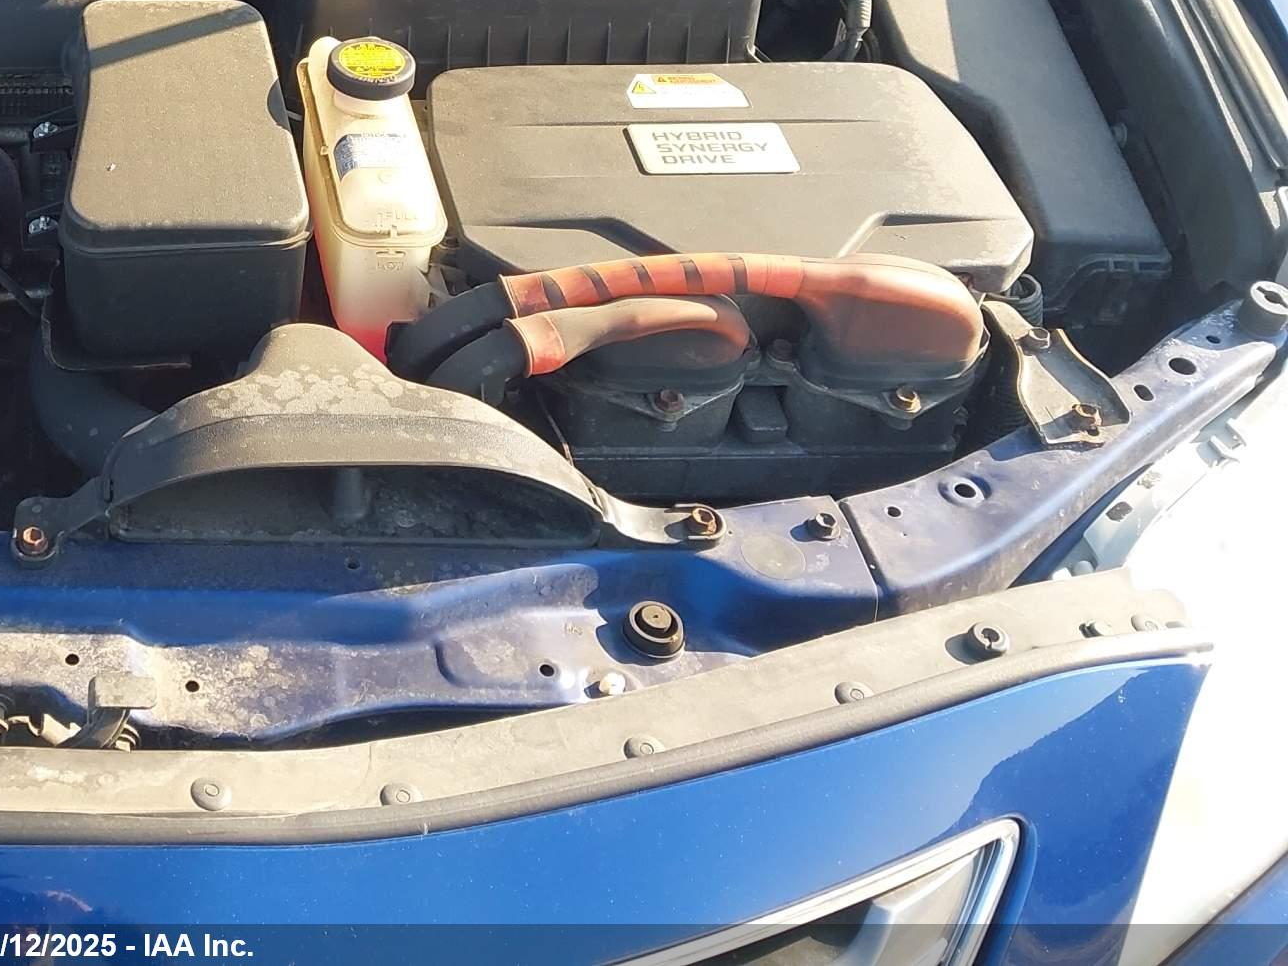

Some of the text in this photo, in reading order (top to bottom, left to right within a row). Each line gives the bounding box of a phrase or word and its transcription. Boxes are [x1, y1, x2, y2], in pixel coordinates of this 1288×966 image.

[652, 131, 743, 141] HYBRID
[656, 142, 769, 153] SYNERGY
[662, 154, 737, 165] DRIVE
